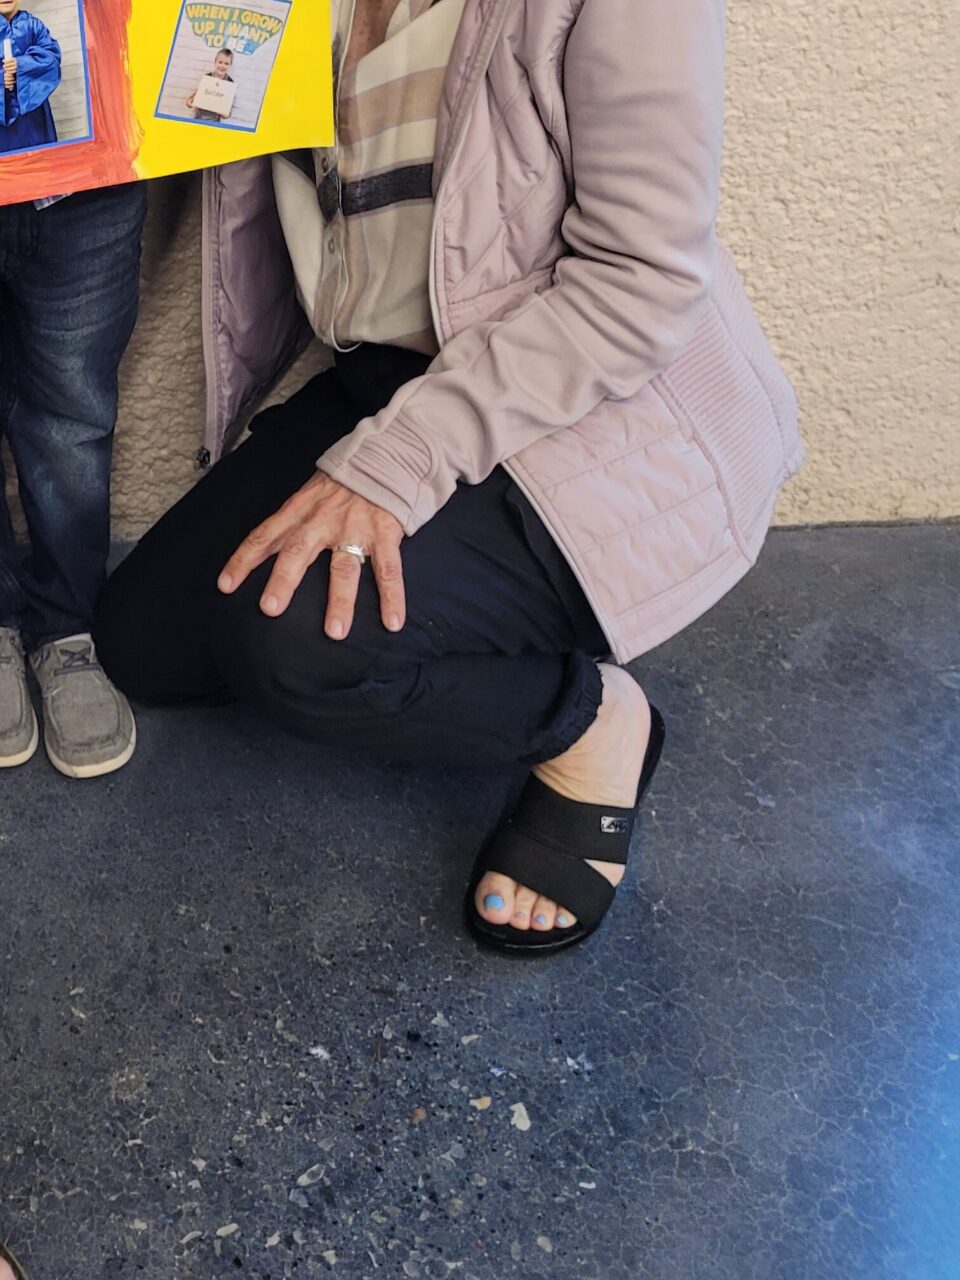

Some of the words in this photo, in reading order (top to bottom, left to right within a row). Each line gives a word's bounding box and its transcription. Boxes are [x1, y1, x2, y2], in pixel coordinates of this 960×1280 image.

[186, 3, 230, 21] WHEN
[232, 8, 240, 22] I
[240, 11, 284, 34] GROW
[193, 21, 215, 35] UP
[218, 21, 225, 35] I
[228, 23, 271, 44] WANT
[206, 34, 225, 48] TO
